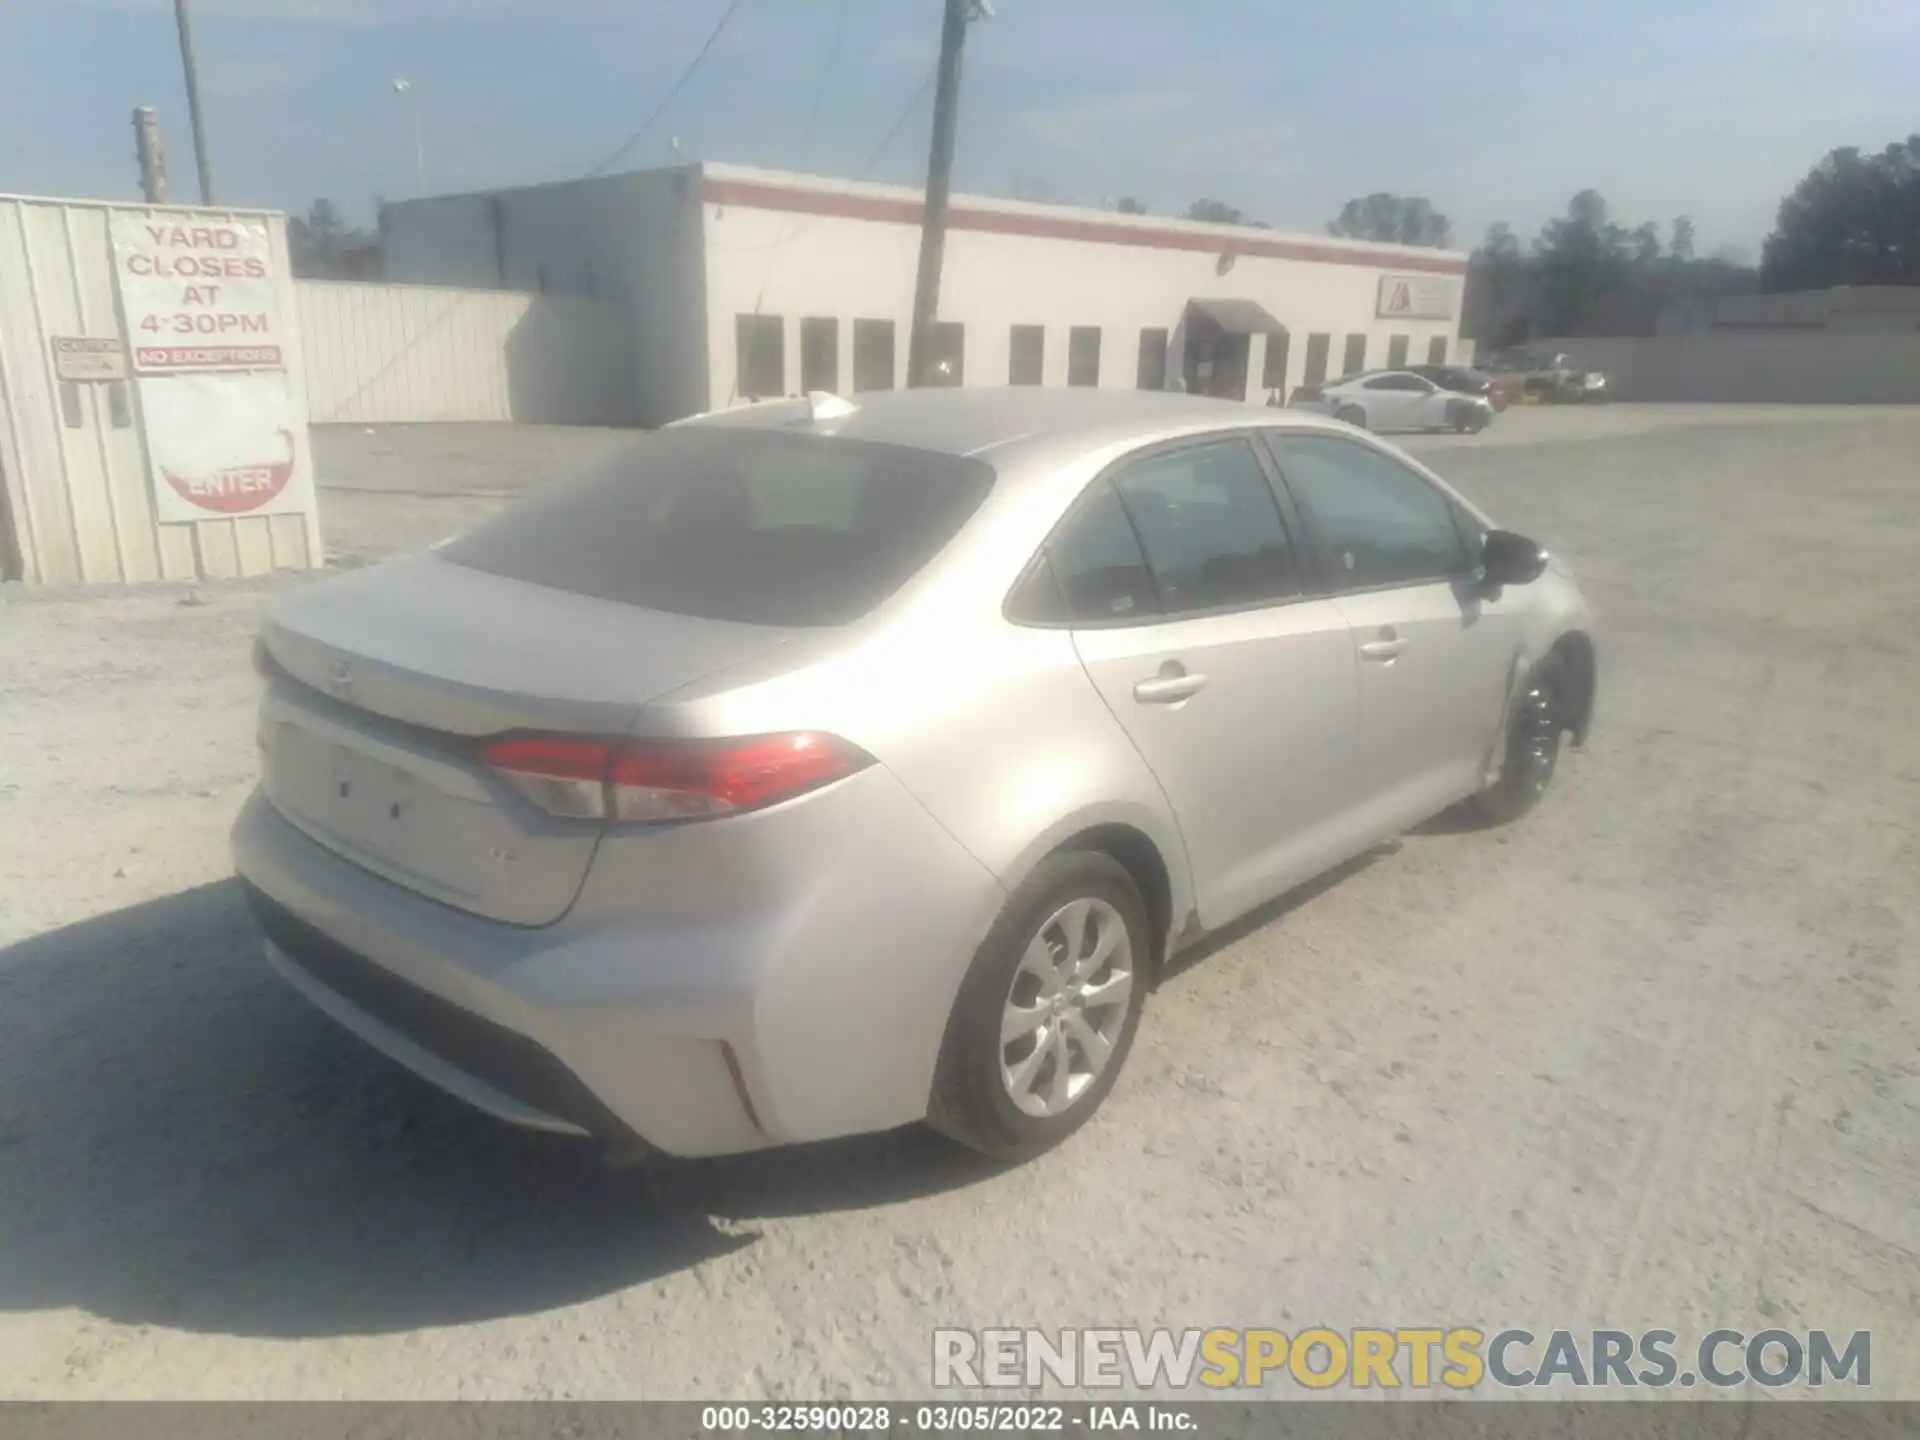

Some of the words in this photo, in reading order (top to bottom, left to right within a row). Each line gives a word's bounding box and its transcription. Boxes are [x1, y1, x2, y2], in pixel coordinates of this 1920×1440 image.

[144, 224, 238, 249] YARD
[126, 254, 266, 278] CLOSES
[182, 285, 221, 305] AT
[140, 312, 268, 334] 4:30PM
[139, 350, 168, 364] NO
[171, 348, 278, 363] EXCEPTIONS
